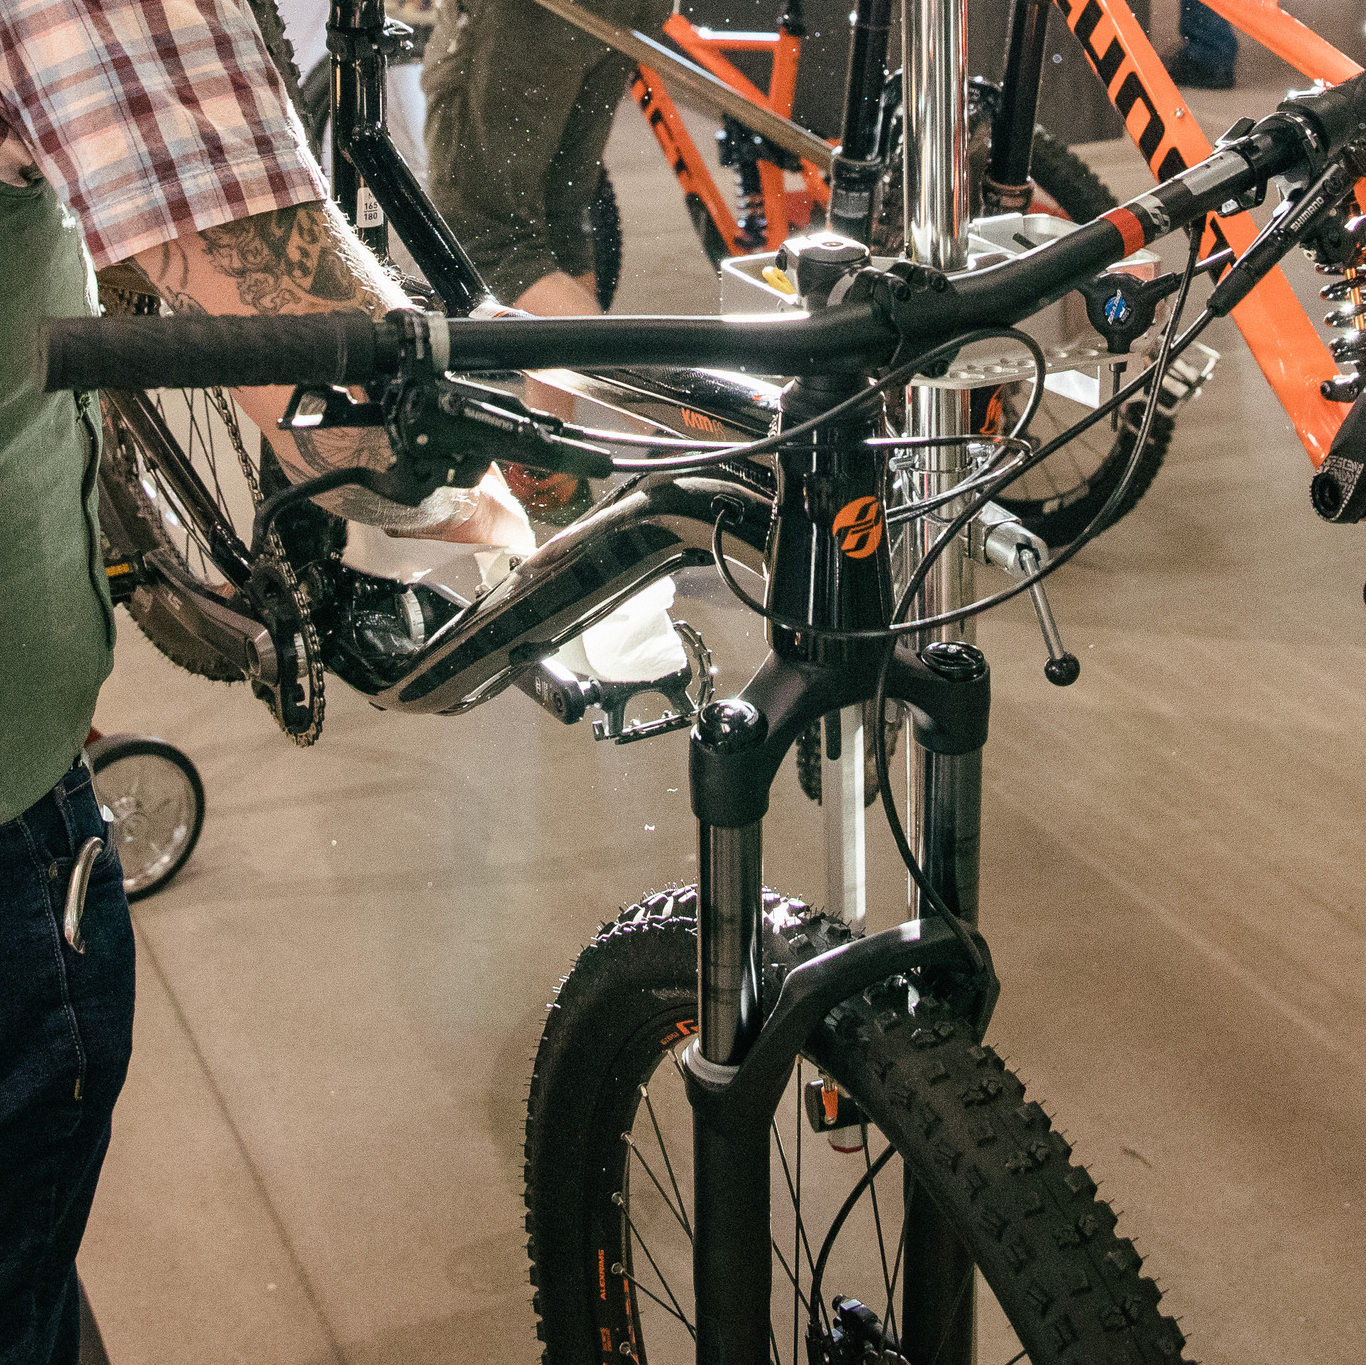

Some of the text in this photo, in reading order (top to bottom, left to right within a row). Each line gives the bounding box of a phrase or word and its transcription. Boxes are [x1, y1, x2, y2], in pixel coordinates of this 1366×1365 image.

[364, 202, 378, 210] 165
[364, 212, 378, 221] 180
[1290, 196, 1324, 232] SHIMANO
[598, 1248, 607, 1301] ALEXRIMS
